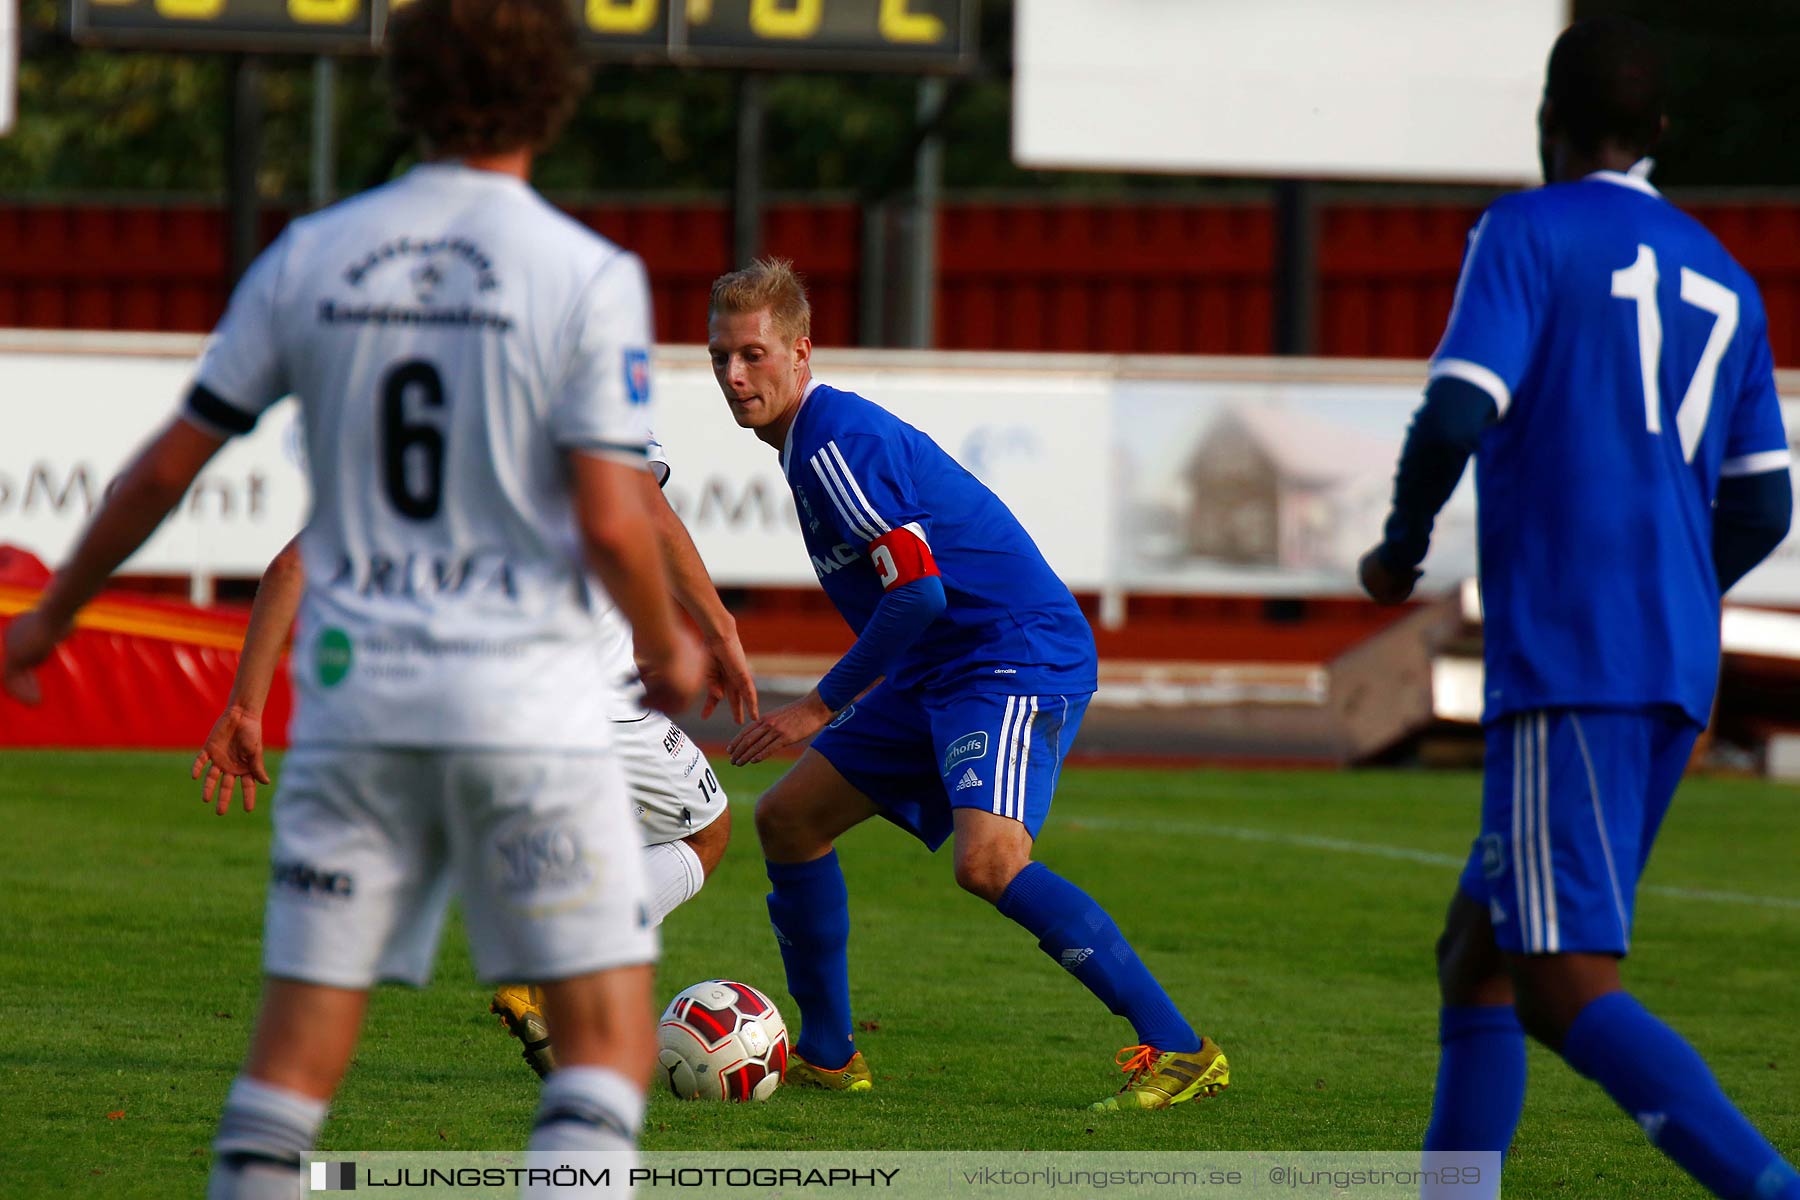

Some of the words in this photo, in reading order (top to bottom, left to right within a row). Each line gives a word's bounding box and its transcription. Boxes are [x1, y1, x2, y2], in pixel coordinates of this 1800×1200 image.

[1611, 242, 1740, 465] 17
[376, 357, 446, 524] 6
[697, 767, 718, 804] 10
[956, 779, 983, 792] adidas
